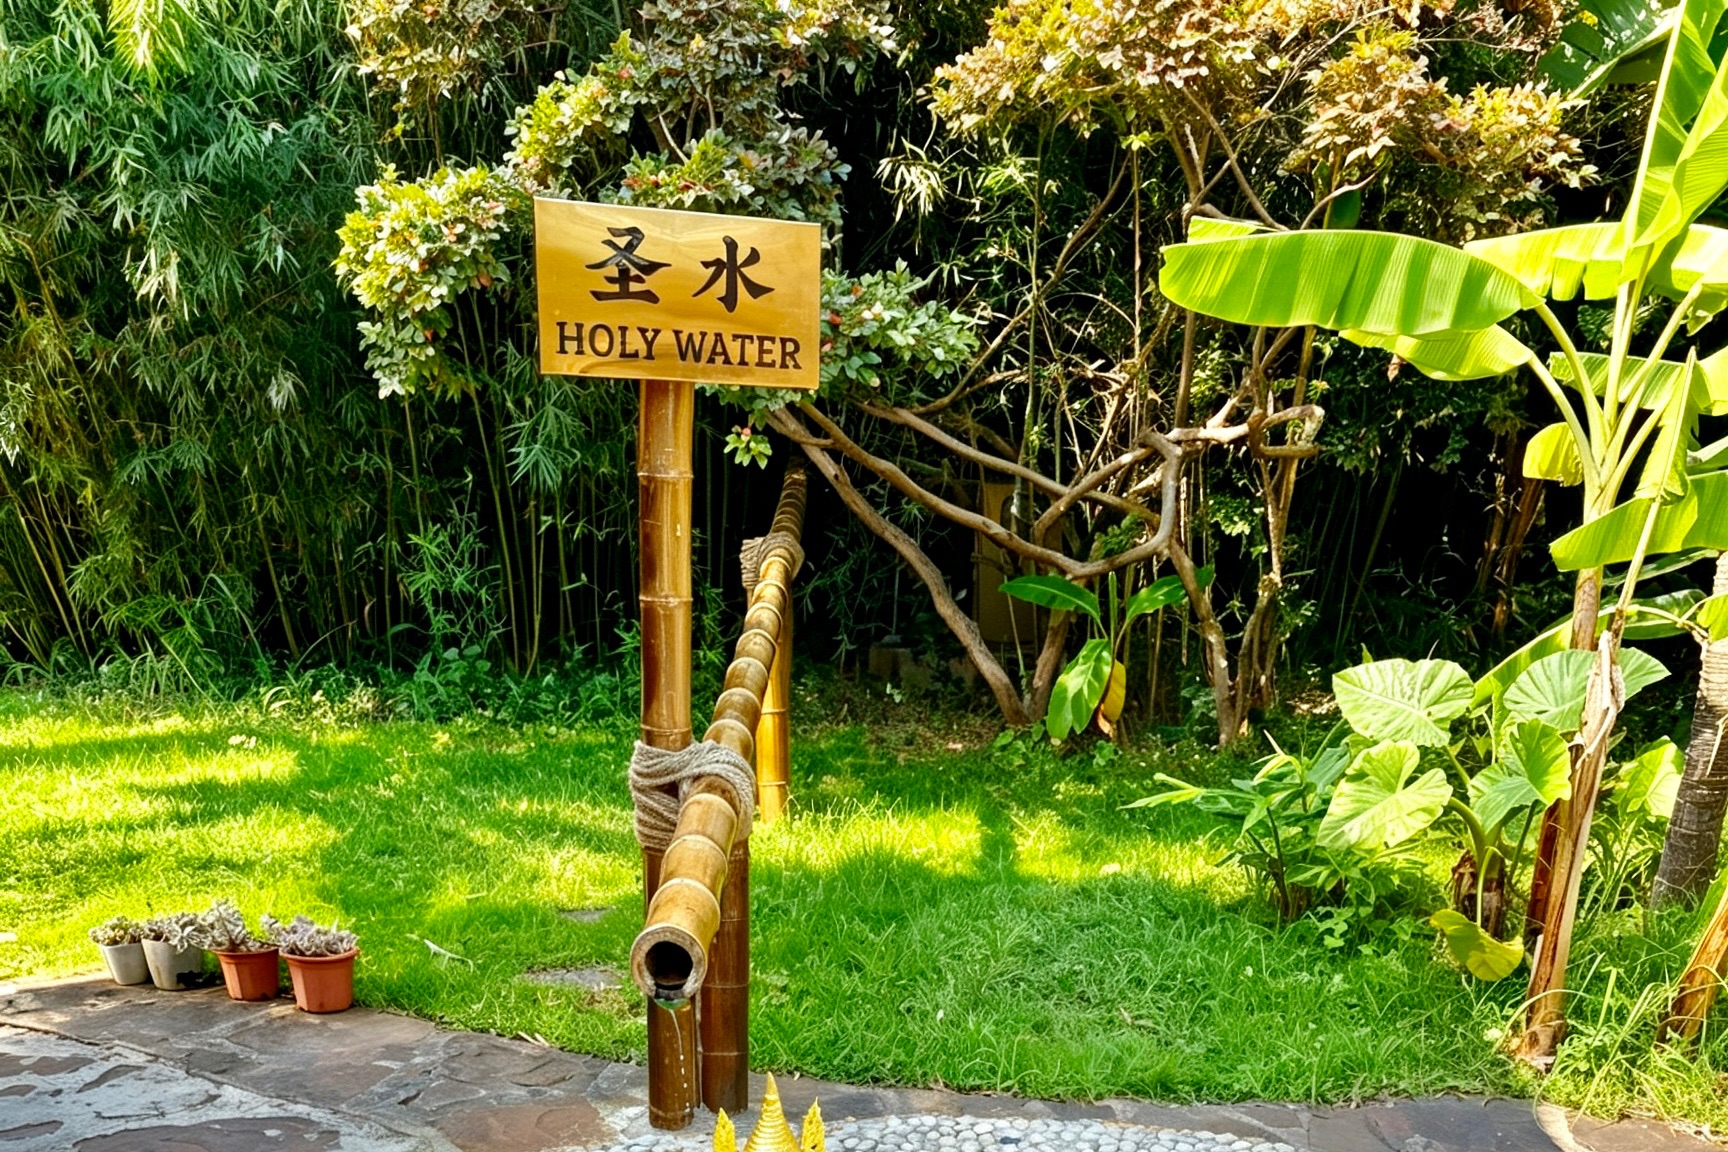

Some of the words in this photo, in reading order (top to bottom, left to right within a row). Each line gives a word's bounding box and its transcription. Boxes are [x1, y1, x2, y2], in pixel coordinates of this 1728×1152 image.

[585, 226, 776, 313] 圣水
[555, 321, 662, 361] HOLY
[672, 329, 803, 370] WATER
